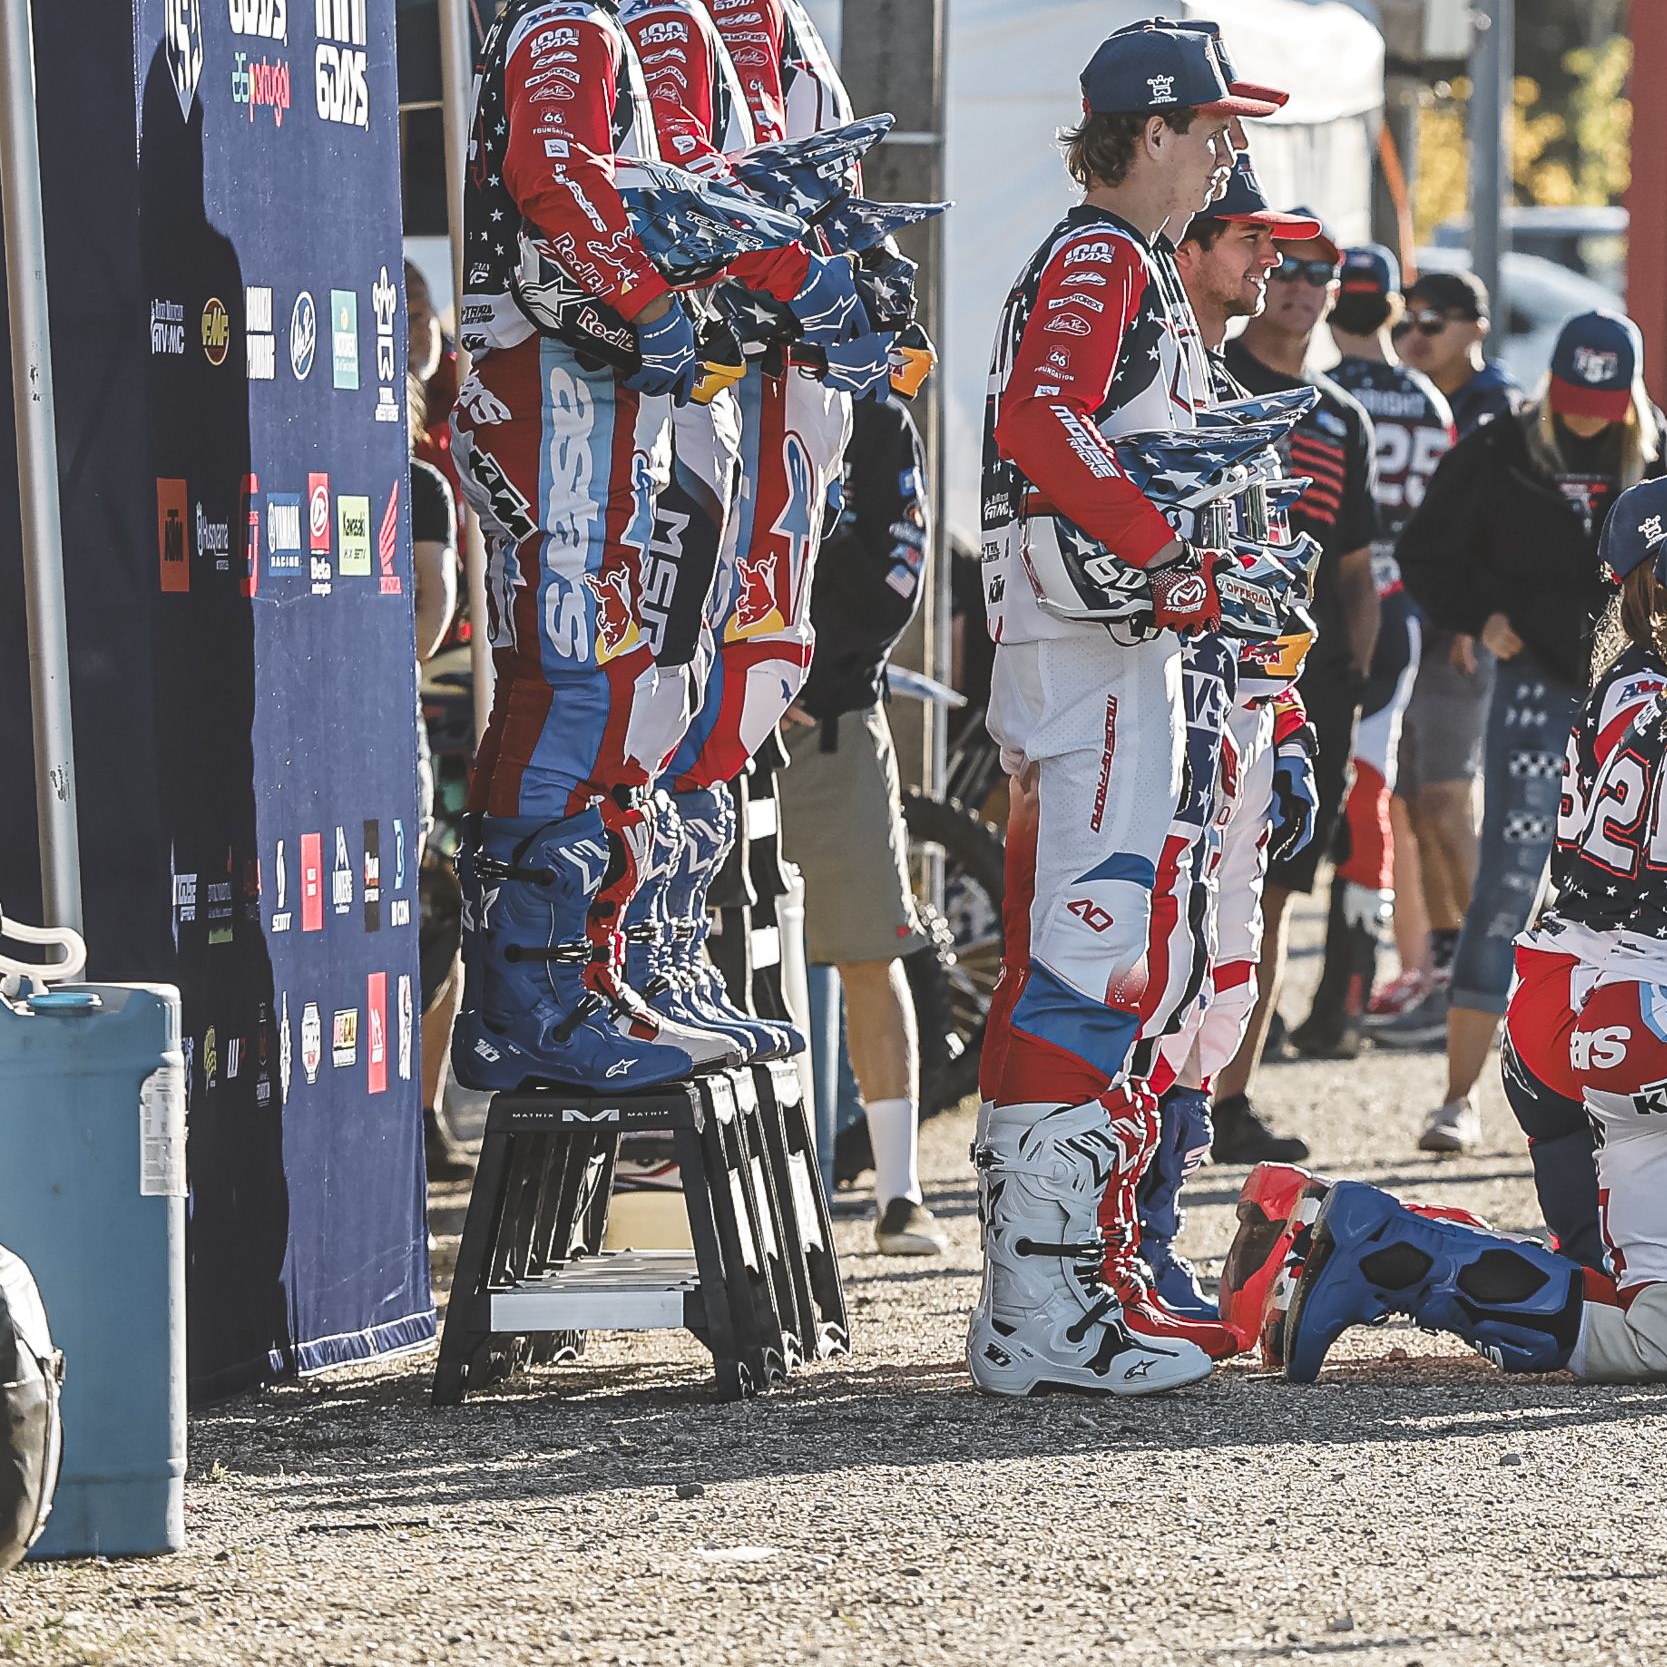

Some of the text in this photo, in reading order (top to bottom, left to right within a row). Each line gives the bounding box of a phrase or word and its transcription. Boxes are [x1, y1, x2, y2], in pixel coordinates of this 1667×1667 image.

[543, 112, 563, 124] 66
[468, 444, 539, 543] KTM
[1226, 584, 1271, 606] OFFROAD
[626, 1109, 670, 1117] MATRIX
